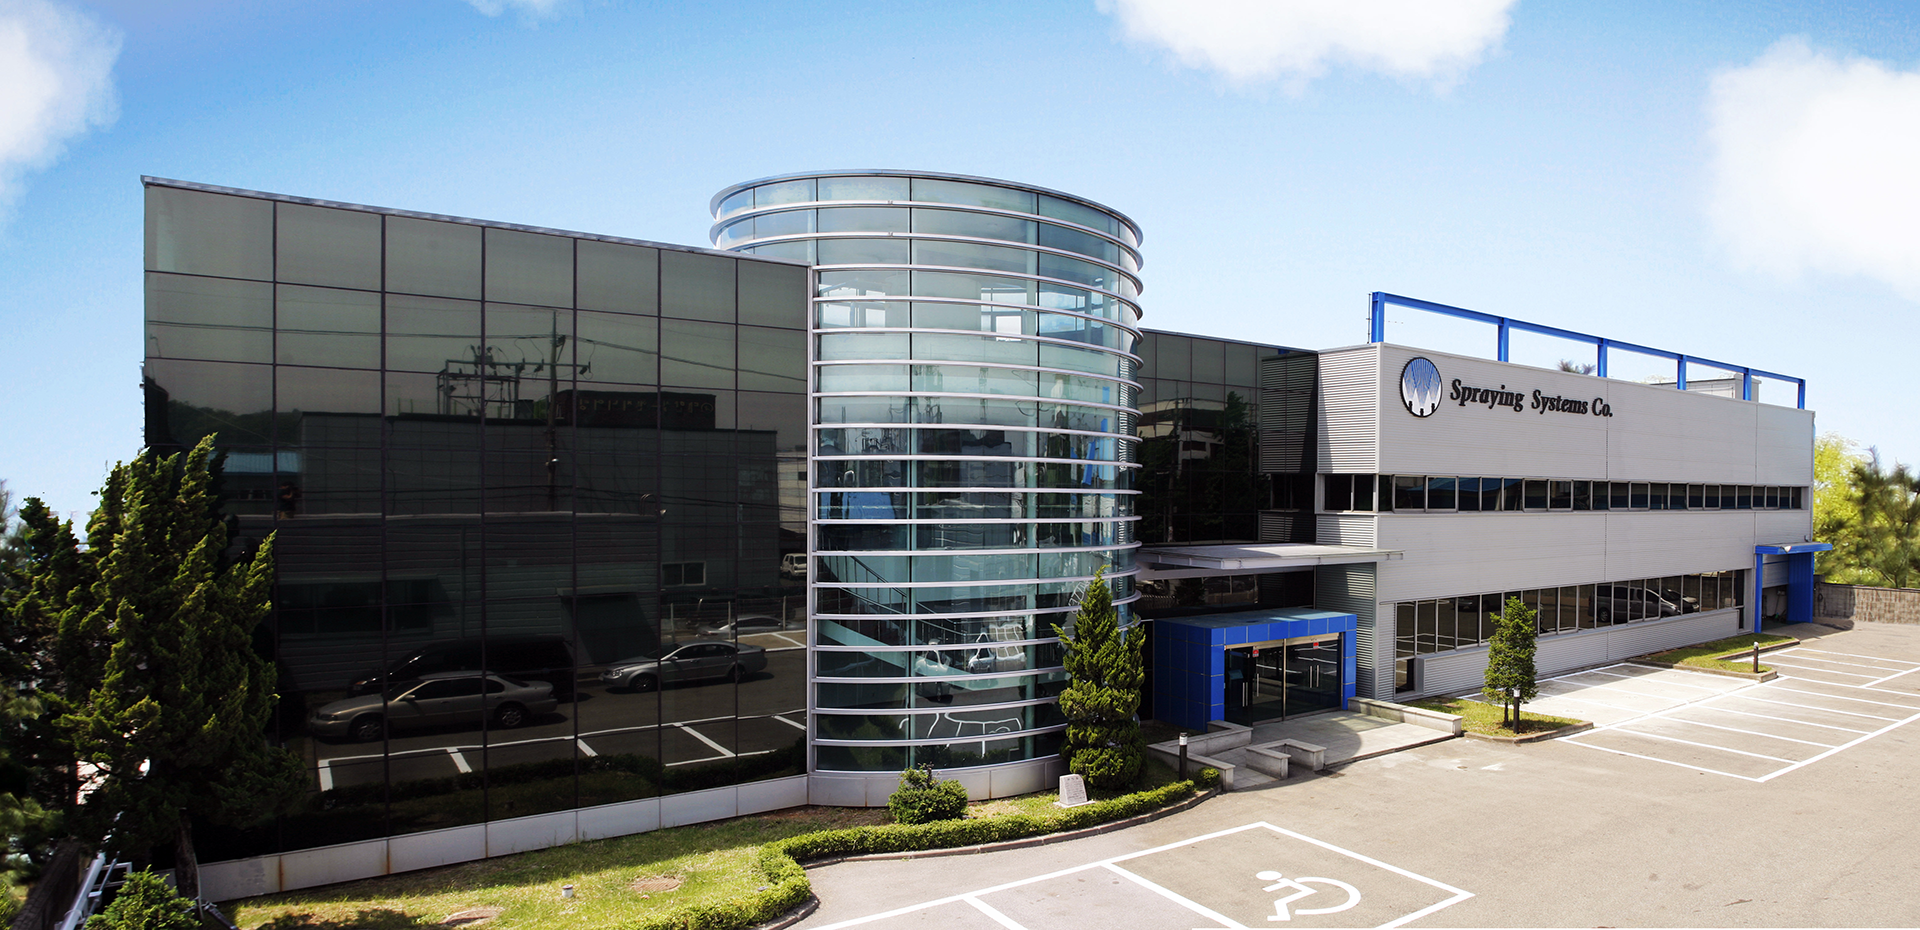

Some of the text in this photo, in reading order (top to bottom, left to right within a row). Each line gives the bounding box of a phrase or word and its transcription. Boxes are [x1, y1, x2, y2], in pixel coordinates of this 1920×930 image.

[1449, 378, 1614, 418] Spraying Systems Co.
